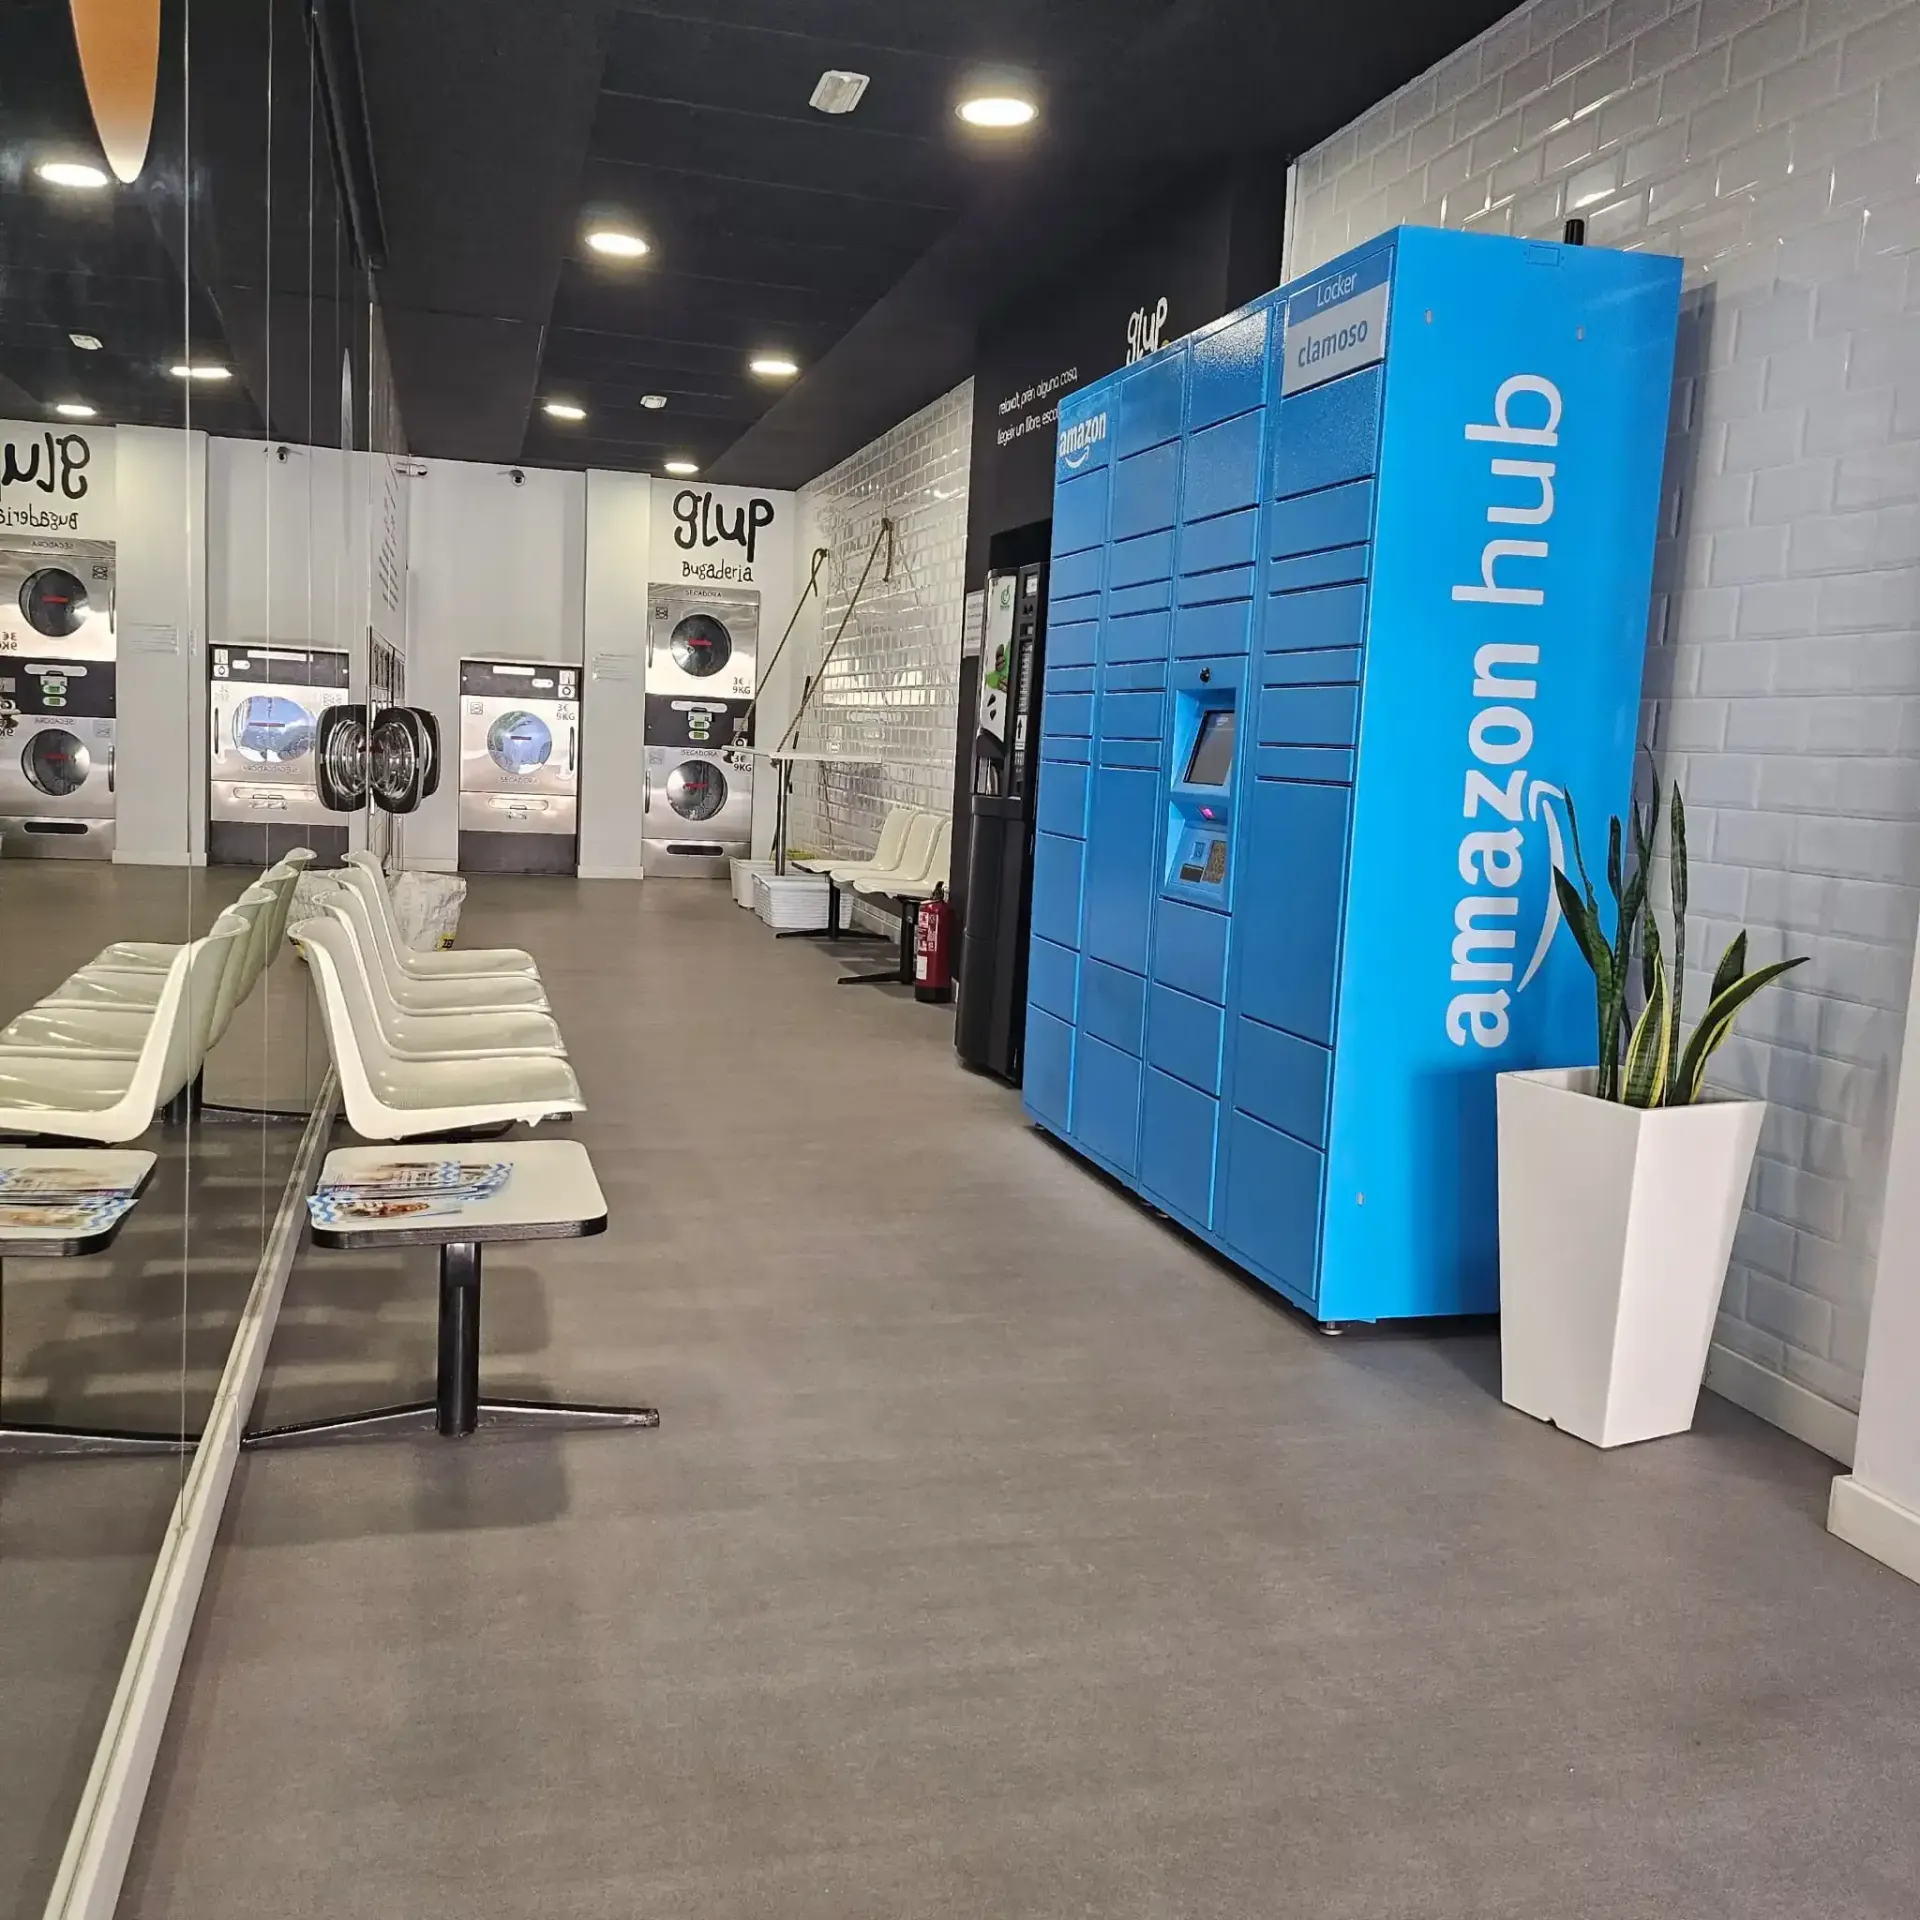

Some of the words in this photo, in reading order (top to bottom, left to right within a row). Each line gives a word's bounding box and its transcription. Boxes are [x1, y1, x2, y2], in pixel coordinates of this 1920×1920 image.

[1317, 273, 1358, 307] Locker
[1298, 320, 1368, 368] clamoso
[1060, 412, 1106, 457] amazon
[1451, 373, 1563, 606] hub
[673, 490, 774, 563] glup
[682, 559, 754, 582] Bugaderia
[685, 590, 722, 598] SECADORA
[732, 686, 751, 694] 9KG
[556, 713, 576, 721] 9KG
[733, 764, 752, 772] 9KG
[1446, 643, 1540, 1049] amazon
